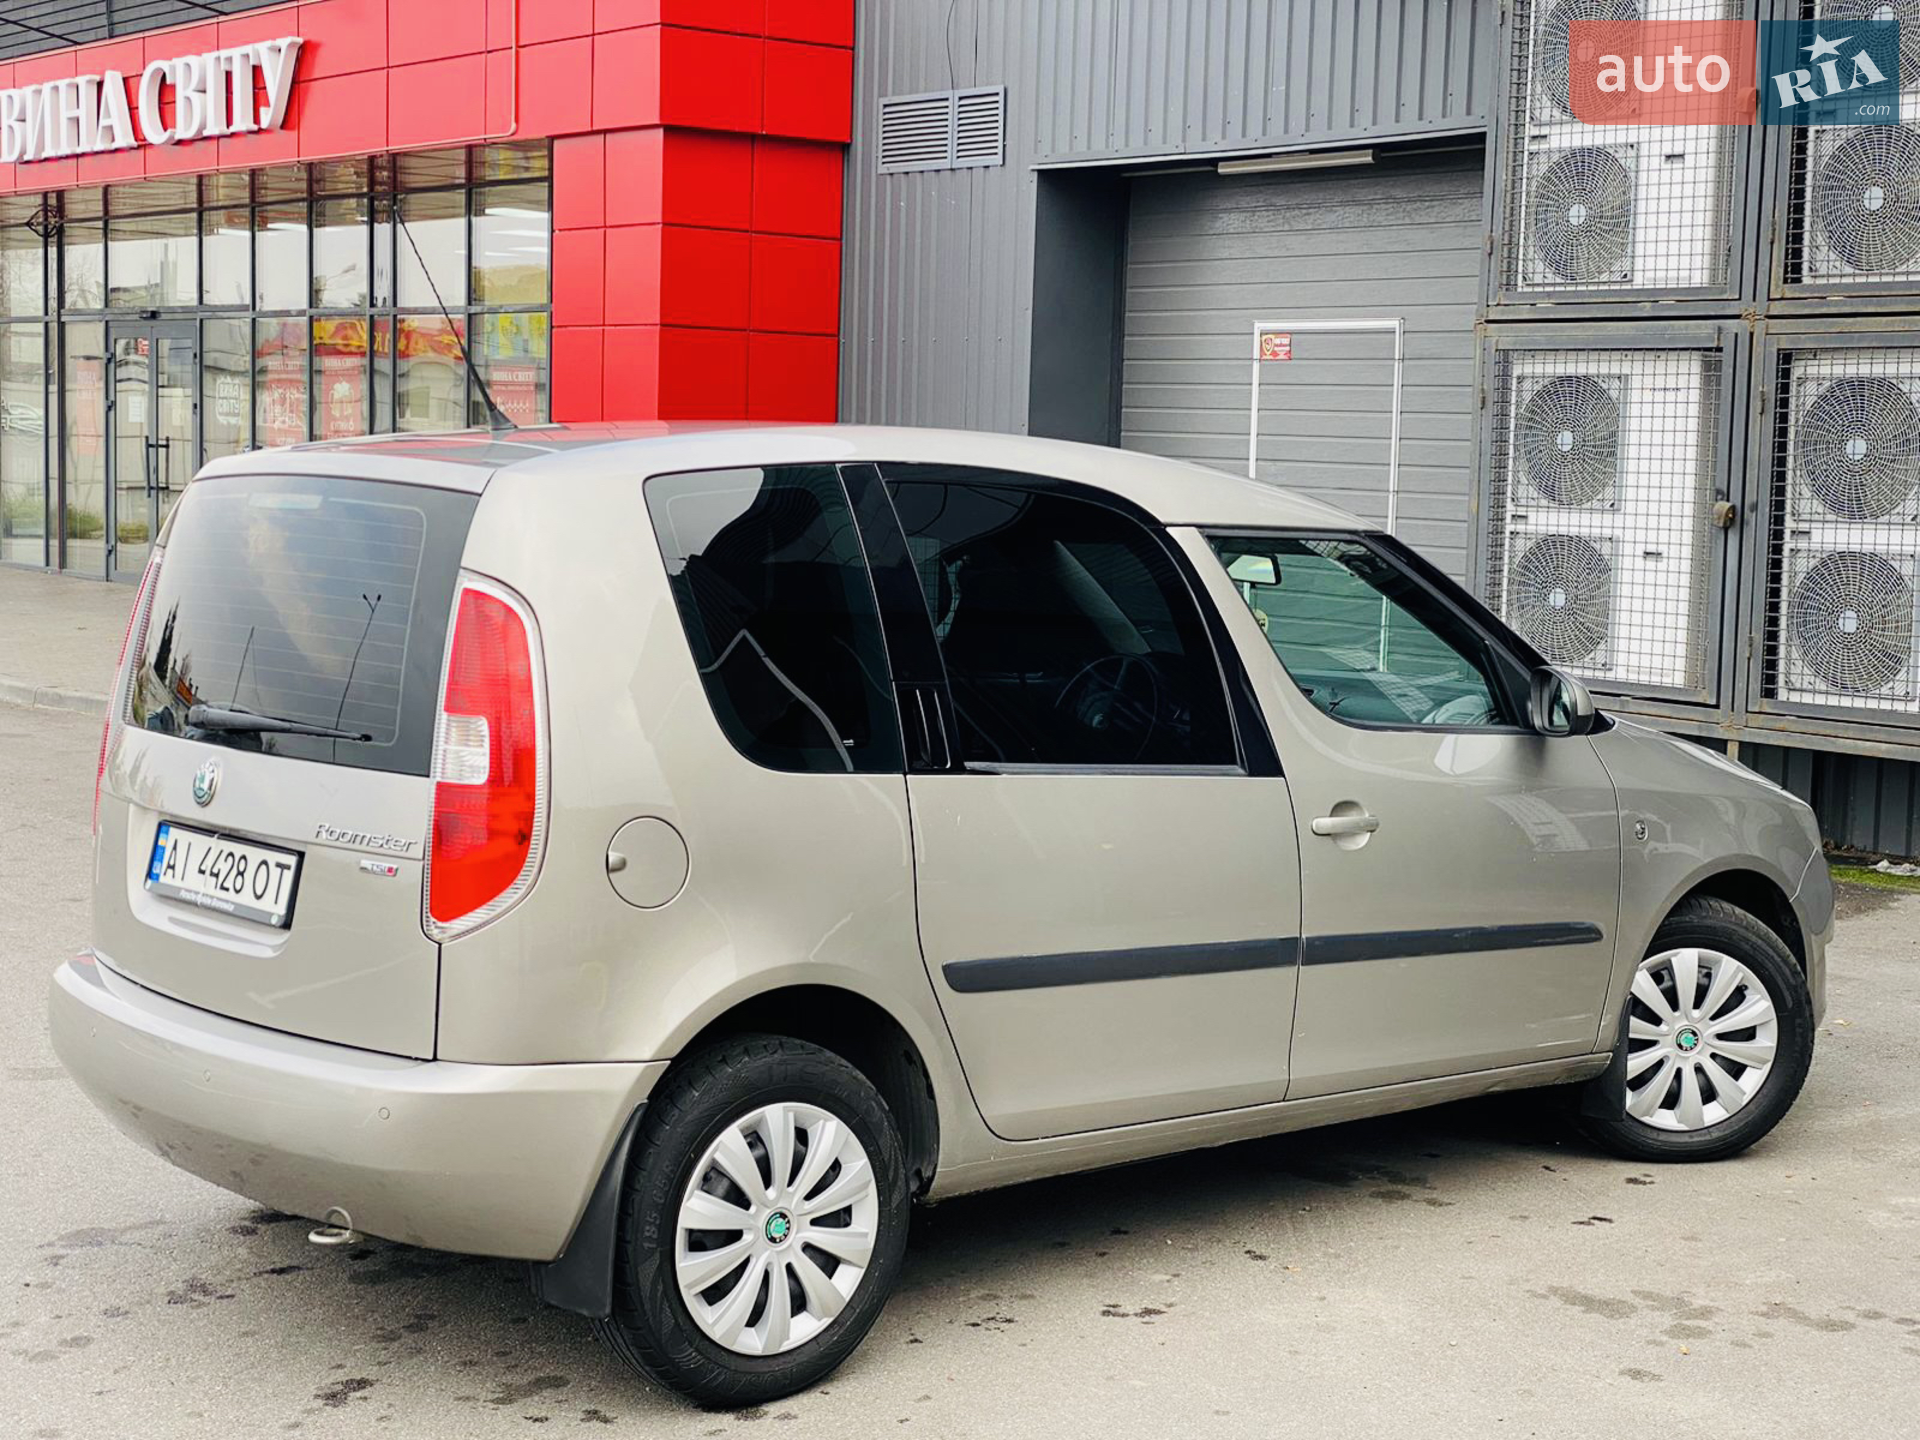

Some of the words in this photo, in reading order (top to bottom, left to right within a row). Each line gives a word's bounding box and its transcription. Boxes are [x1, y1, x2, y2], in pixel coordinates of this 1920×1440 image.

[0, 69, 138, 164] ВИНА
[138, 36, 303, 145] СВІТУ
[315, 823, 418, 852] Roomster
[198, 846, 248, 894] 4428
